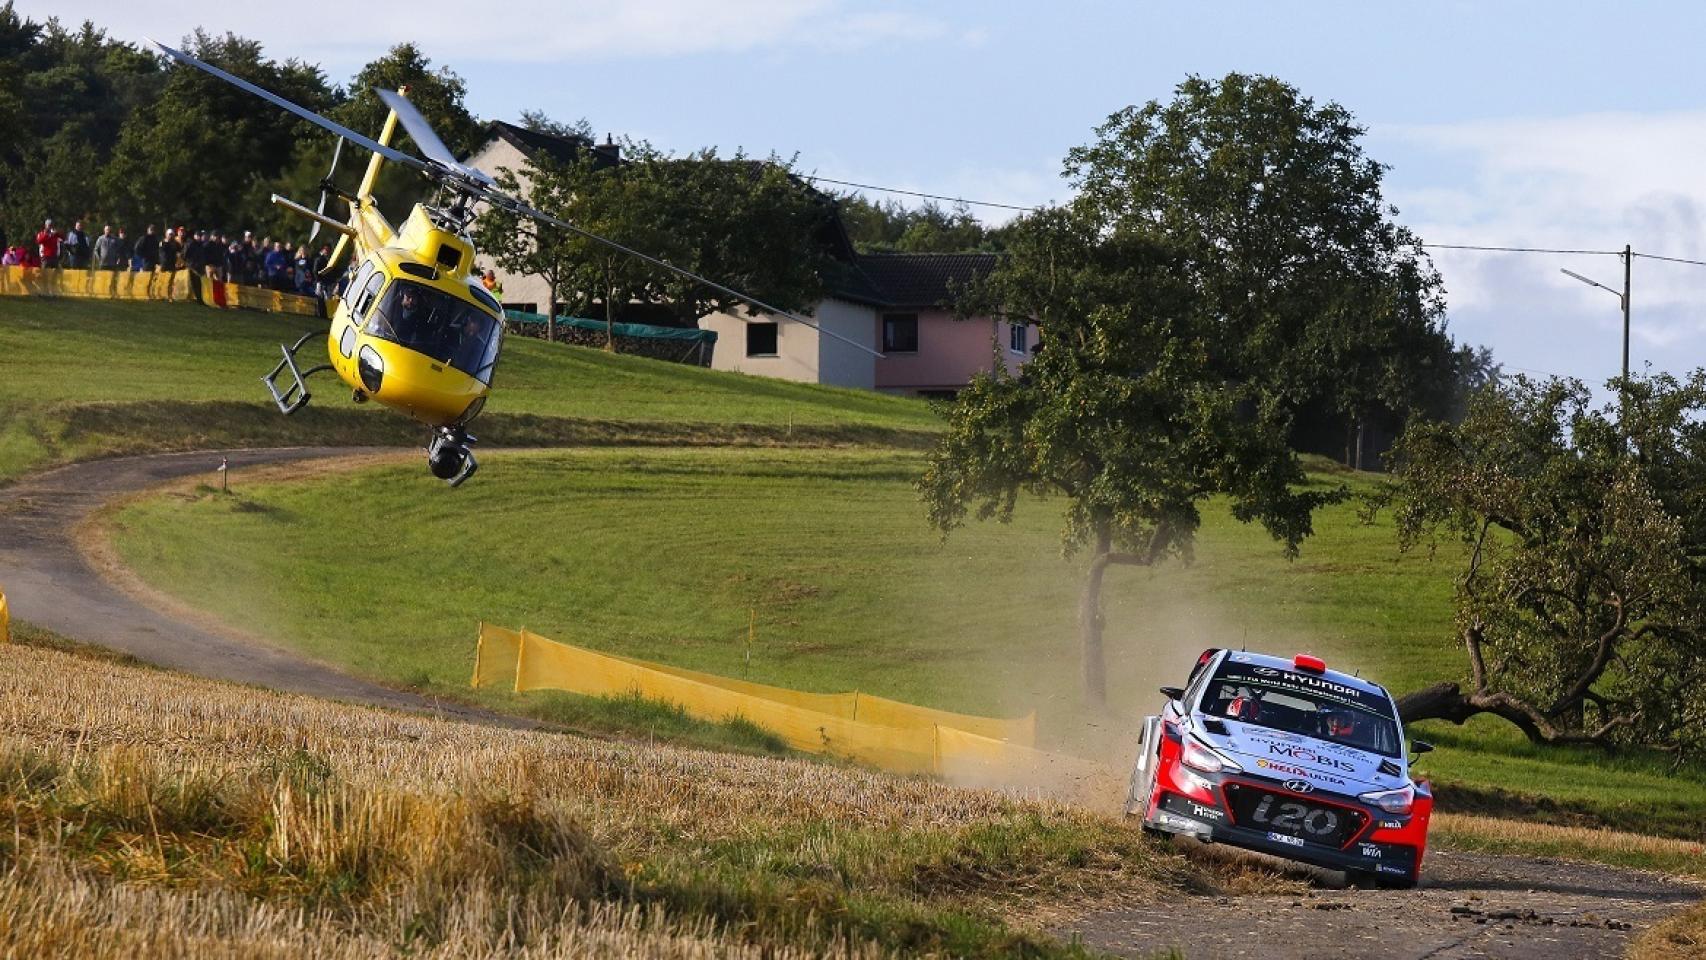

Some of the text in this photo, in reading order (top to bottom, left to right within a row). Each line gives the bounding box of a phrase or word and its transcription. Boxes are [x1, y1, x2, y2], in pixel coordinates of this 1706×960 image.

[1283, 672, 1361, 698] HYUNDAI
[1269, 745, 1355, 772] MOBIS
[1269, 762, 1345, 786] HELIX ULTRA
[1252, 794, 1338, 835] i20
